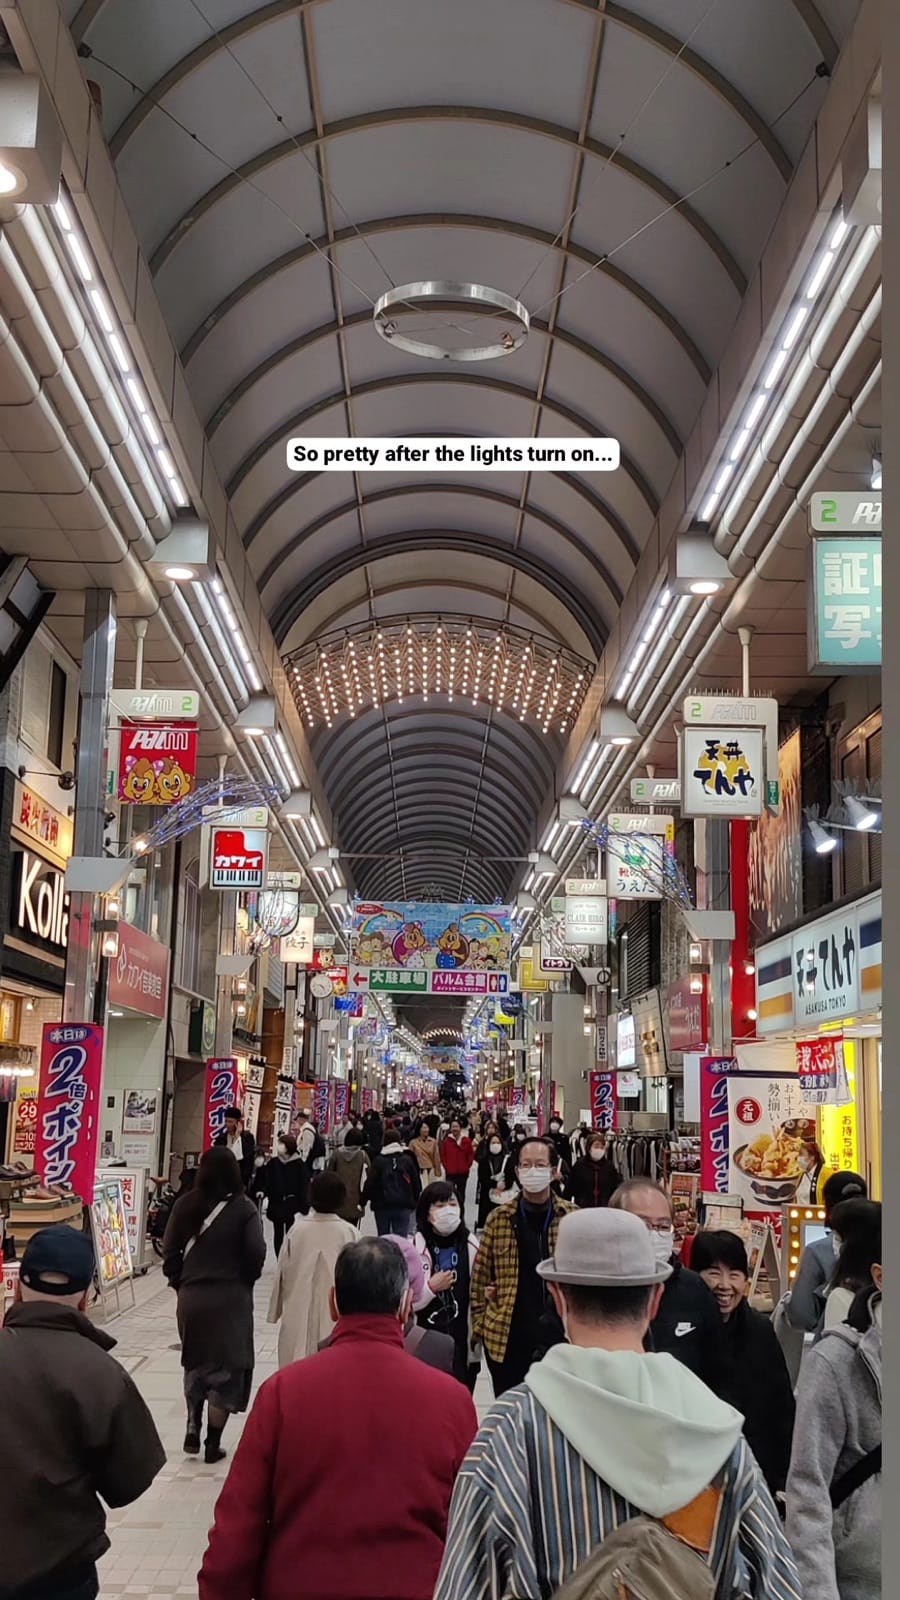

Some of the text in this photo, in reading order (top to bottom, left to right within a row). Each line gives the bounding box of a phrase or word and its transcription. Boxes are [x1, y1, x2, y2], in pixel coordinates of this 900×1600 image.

[821, 500, 837, 522] 2
[822, 552, 882, 596] 証
[824, 605, 882, 649] 写
[181, 696, 192, 711] 2
[691, 702, 701, 717] 2
[693, 768, 754, 796] てんや
[215, 855, 262, 868] カワイ
[828, 994, 848, 1011] TOKYO
[51, 1028, 88, 1044] 本日は
[20, 1105, 38, 1118] 29
[742, 1102, 756, 1122] 元祖
